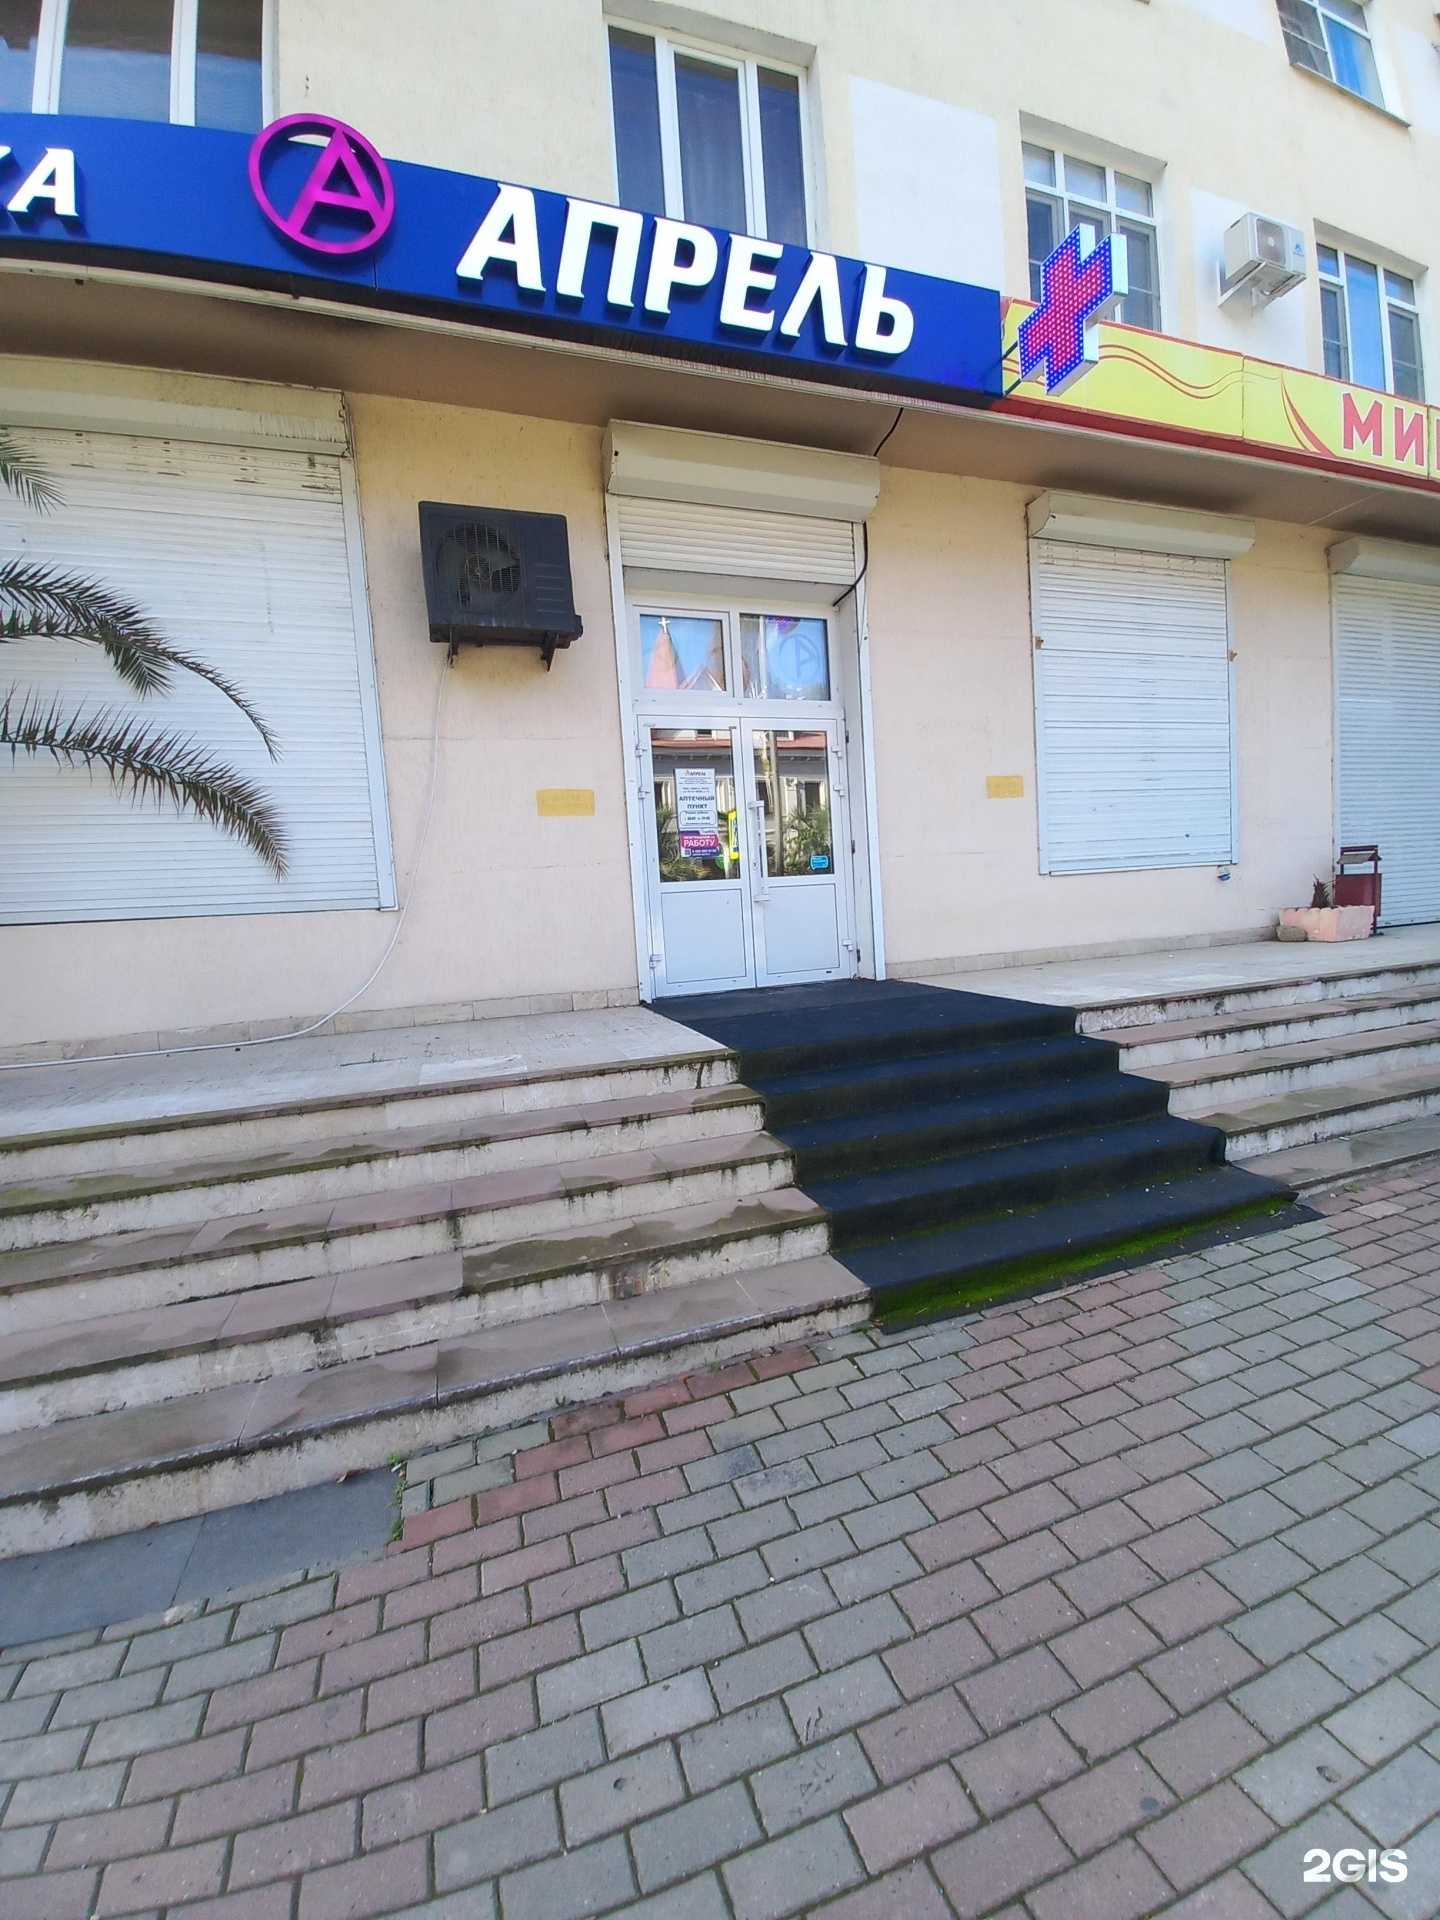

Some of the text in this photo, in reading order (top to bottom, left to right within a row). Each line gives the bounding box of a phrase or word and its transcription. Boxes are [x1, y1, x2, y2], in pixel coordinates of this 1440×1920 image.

[0, 145, 80, 216] А
[456, 182, 915, 355] АПРЕЛЬ
[683, 839, 715, 847] РАБОТУ
